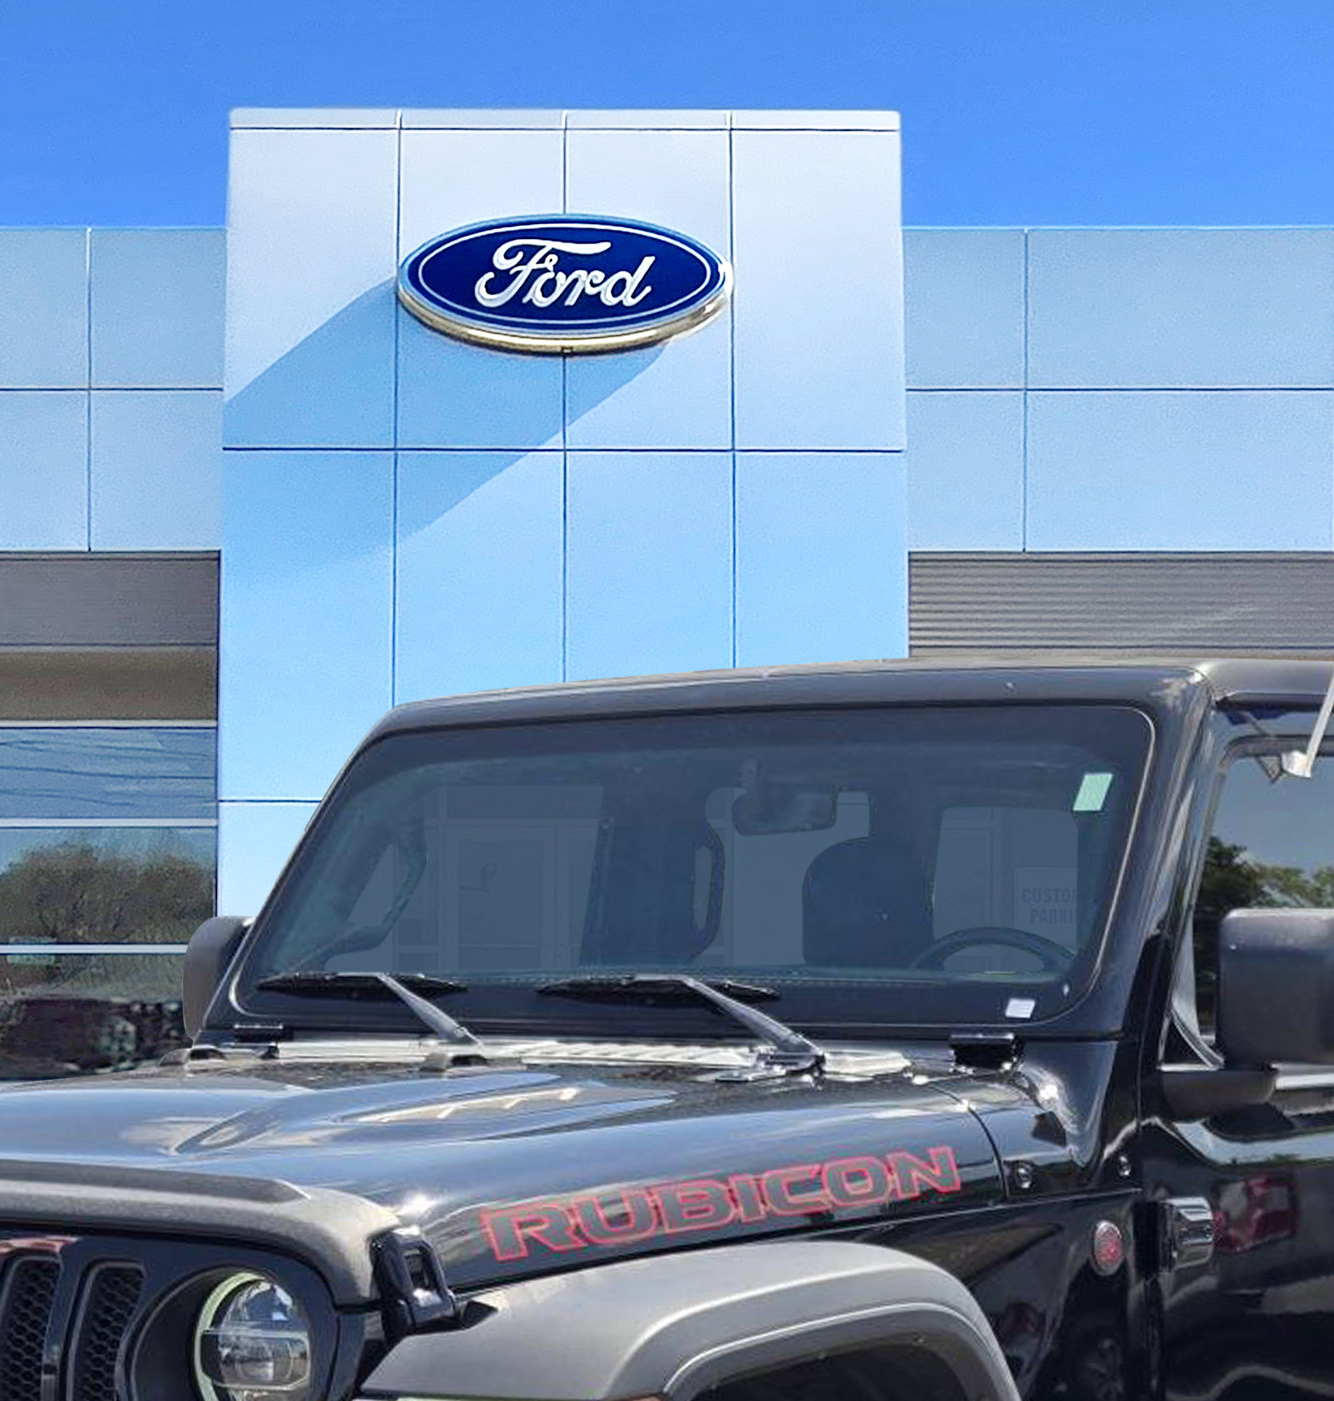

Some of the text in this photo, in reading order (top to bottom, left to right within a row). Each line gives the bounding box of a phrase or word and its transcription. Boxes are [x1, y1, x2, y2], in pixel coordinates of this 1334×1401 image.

[474, 237, 656, 308] Ford
[1021, 887, 1077, 904] CUSTO
[1029, 908, 1077, 924] PARKI
[479, 1144, 963, 1262] RUBICON
